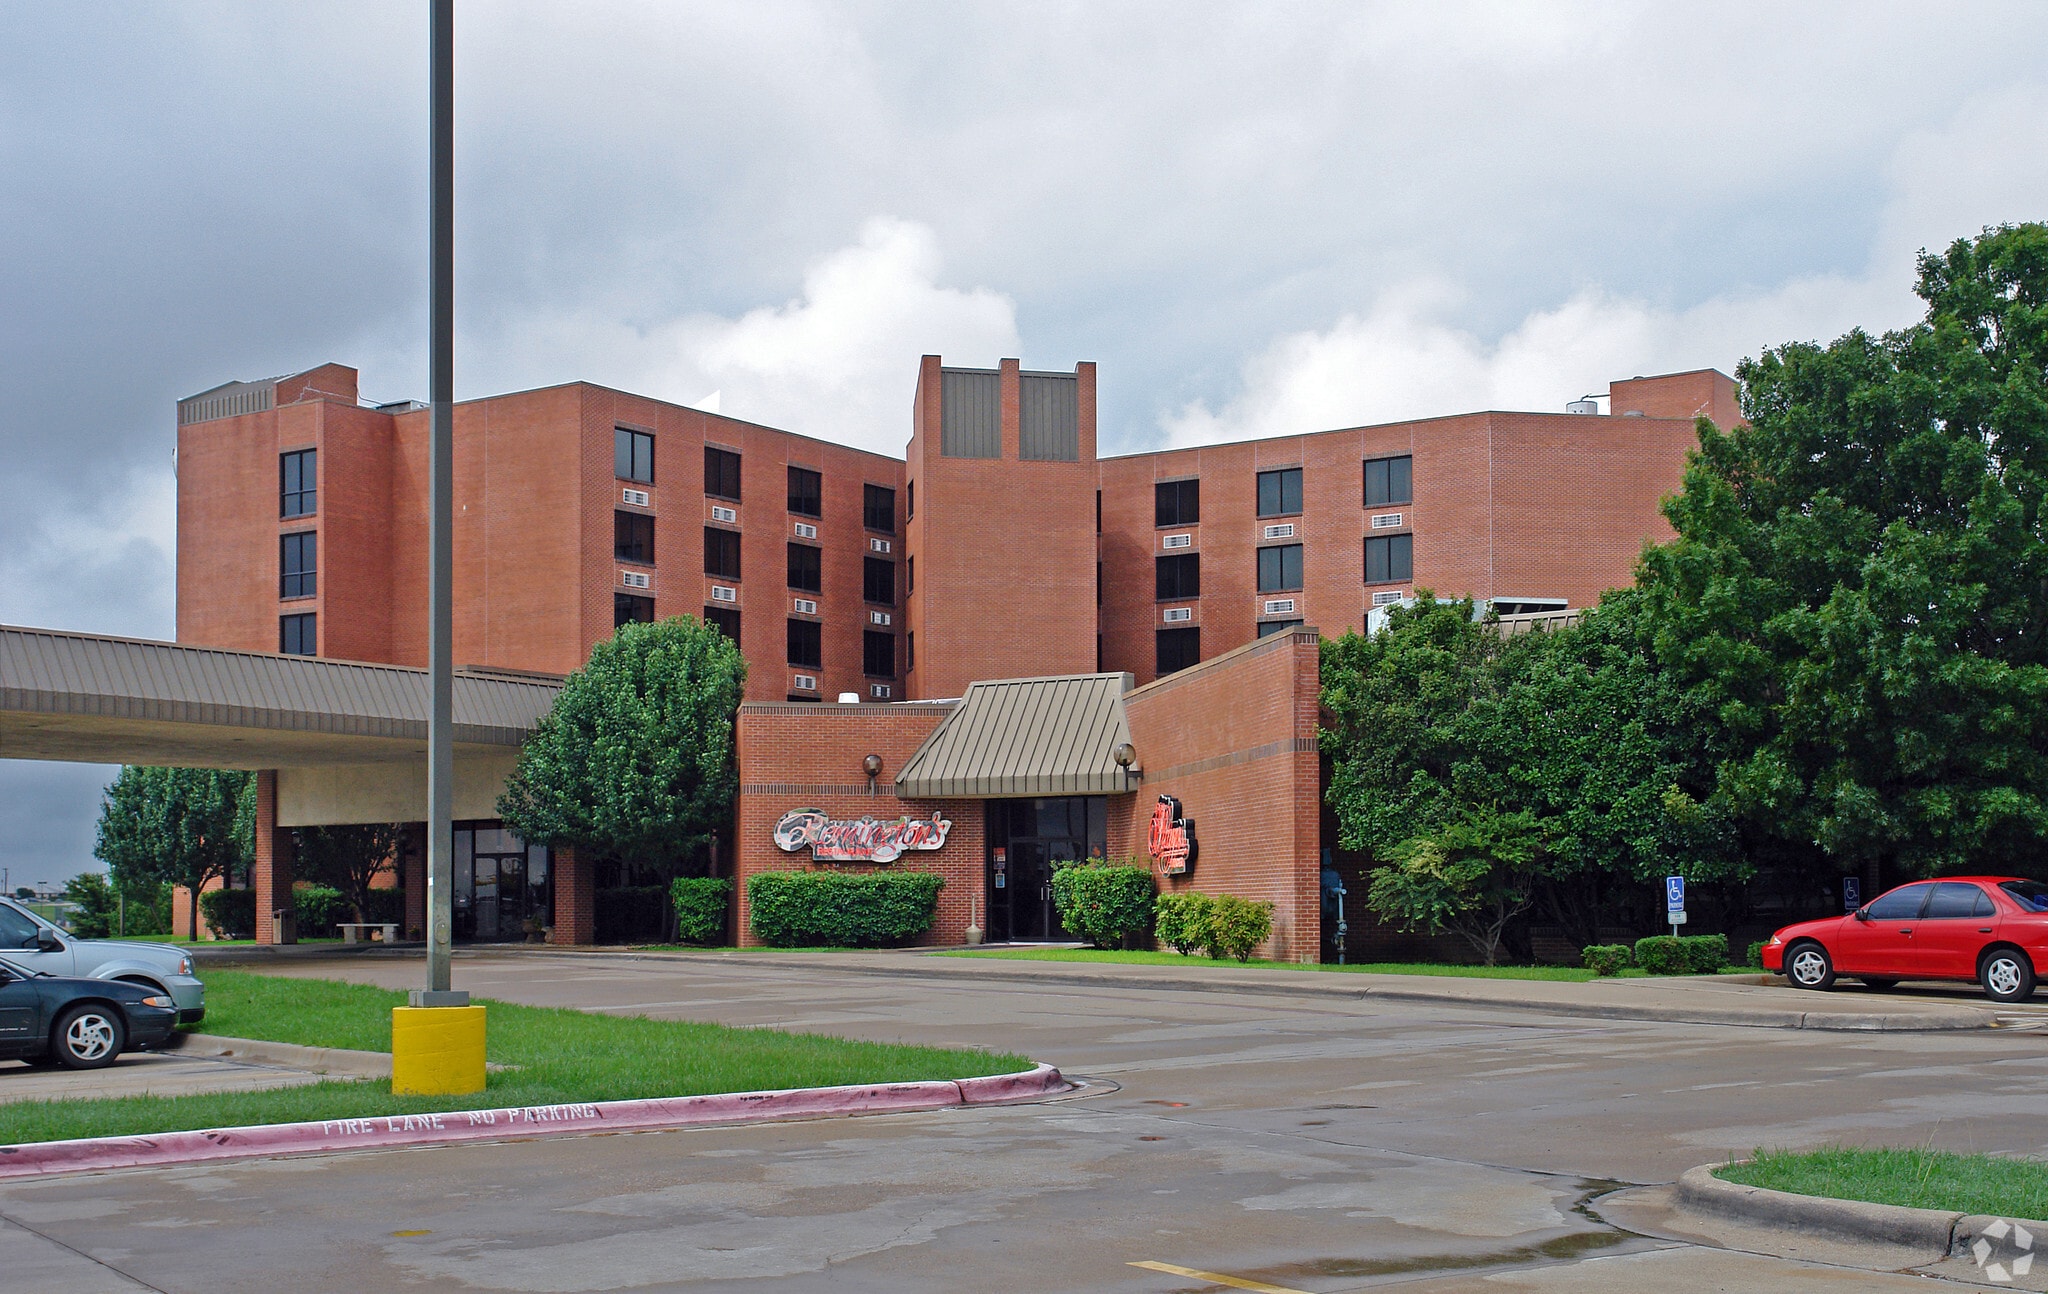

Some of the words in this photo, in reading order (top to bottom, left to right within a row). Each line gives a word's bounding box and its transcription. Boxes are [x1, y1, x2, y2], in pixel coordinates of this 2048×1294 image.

[322, 1119, 373, 1135] FIRE
[386, 1115, 445, 1132] LANE
[467, 1111, 496, 1126] NO
[507, 1105, 596, 1123] PARKING
